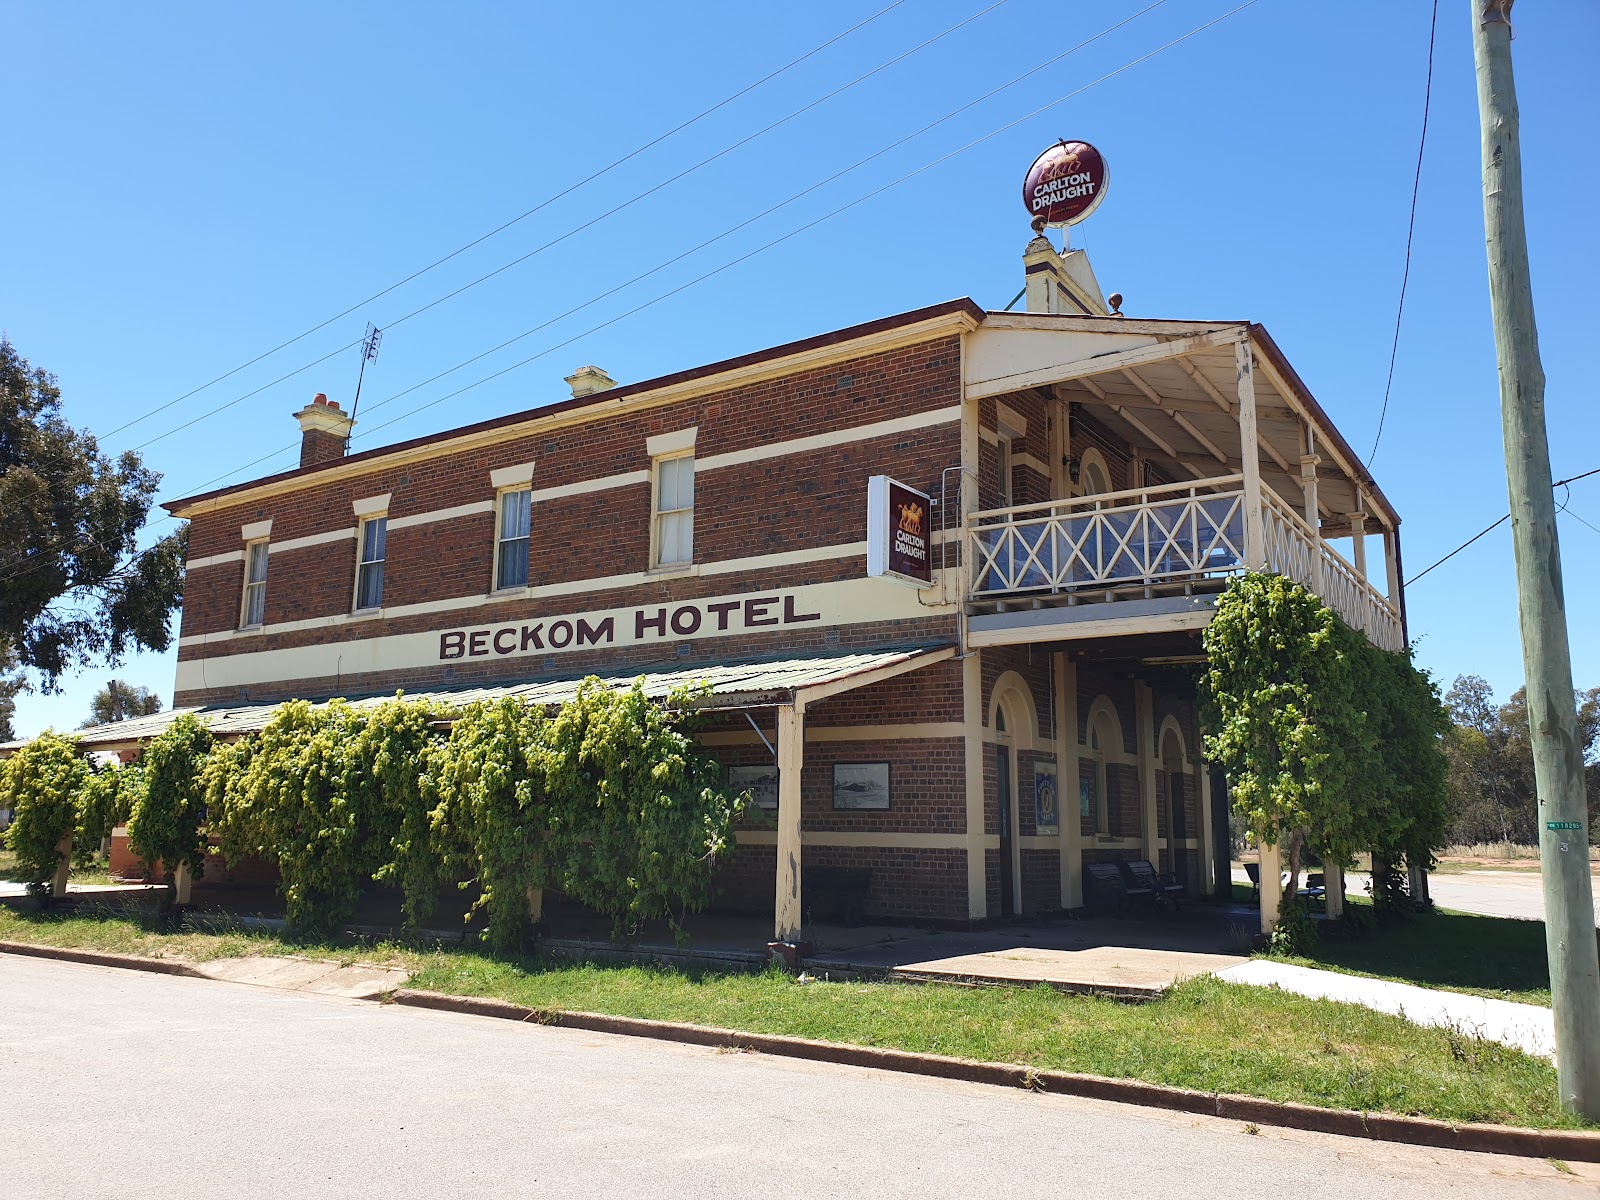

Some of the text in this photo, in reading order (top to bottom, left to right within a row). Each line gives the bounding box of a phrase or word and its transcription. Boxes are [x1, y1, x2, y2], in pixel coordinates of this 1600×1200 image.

[1033, 171, 1091, 198] CARLTON
[1032, 182, 1096, 212] DRAUGHT
[895, 539, 926, 561] DRAUGHT
[897, 529, 925, 550] CARLTON
[439, 595, 821, 660] BECKOM HOTEL
[1560, 841, 1569, 852] 3
